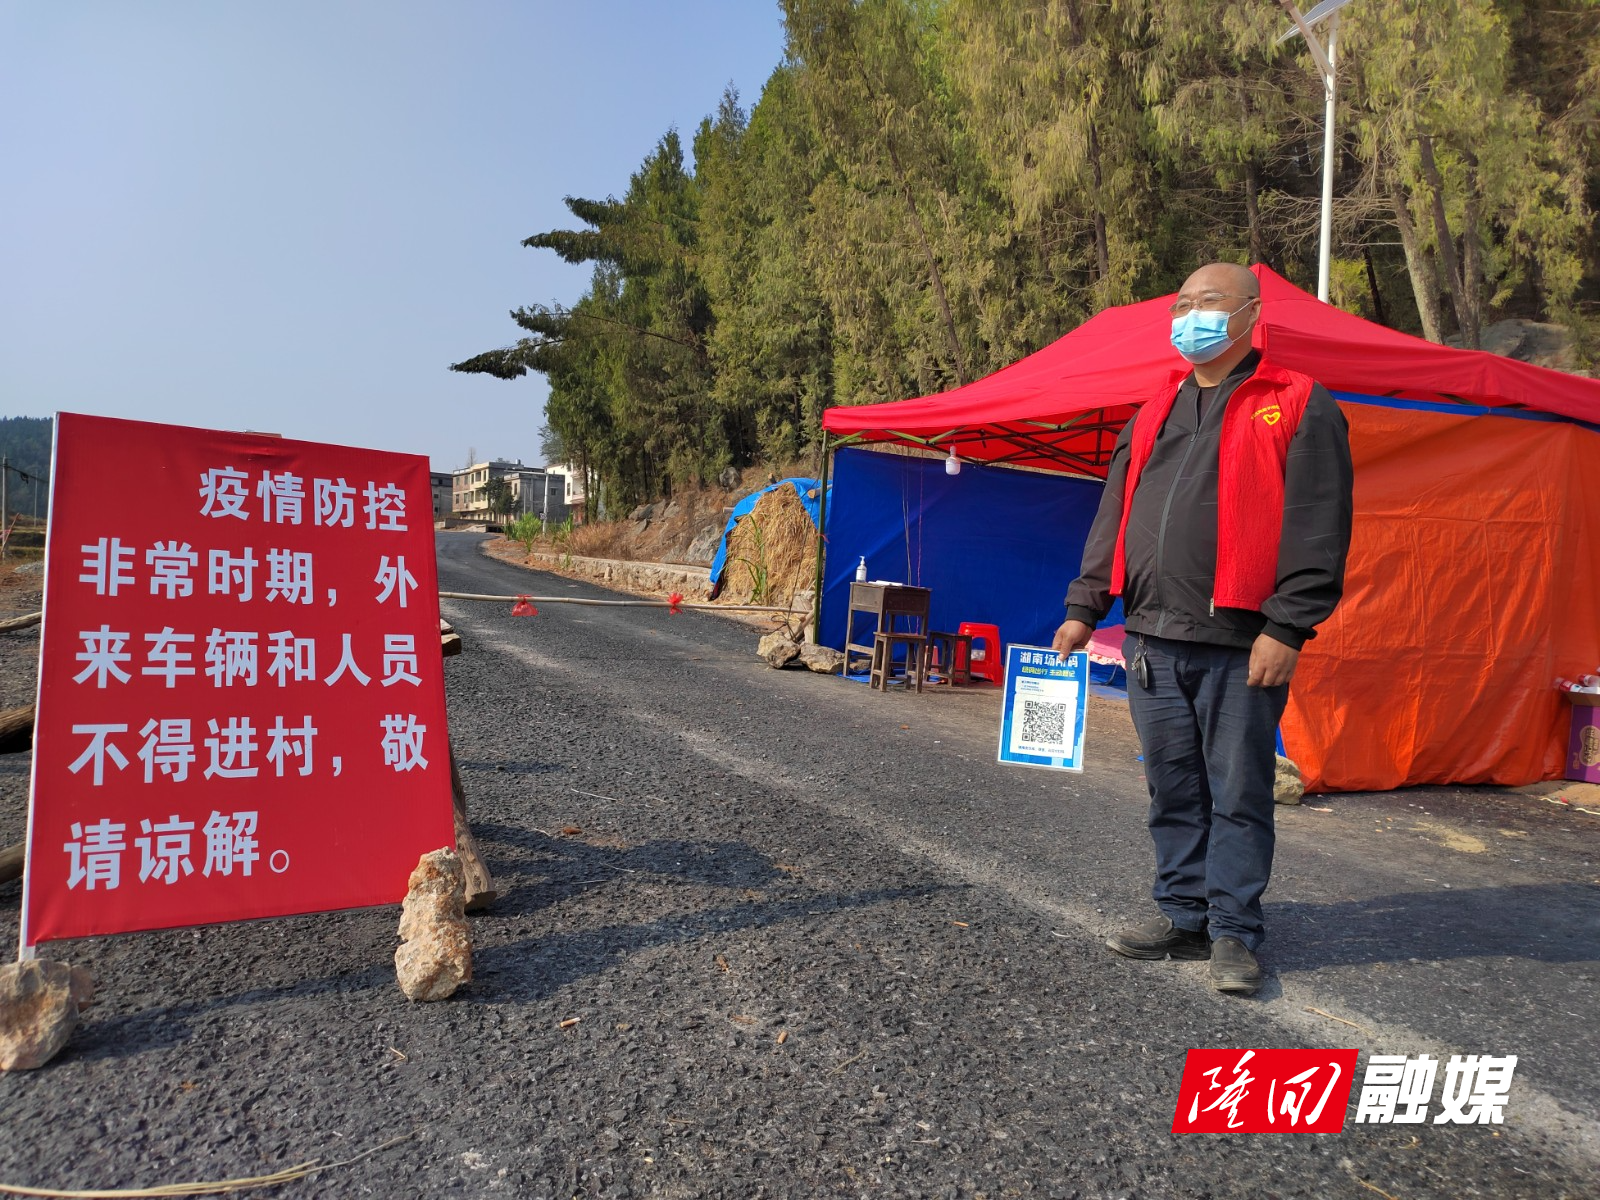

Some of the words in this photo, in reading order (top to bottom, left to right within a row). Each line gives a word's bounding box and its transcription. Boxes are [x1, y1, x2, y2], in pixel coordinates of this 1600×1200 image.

[199, 466, 408, 532] 疫情防控
[79, 537, 419, 608] 非常时期，外
[72, 625, 423, 689] 来车辆和人员
[68, 714, 428, 786] 不得进村，敬
[63, 810, 290, 891] 请谅解。
